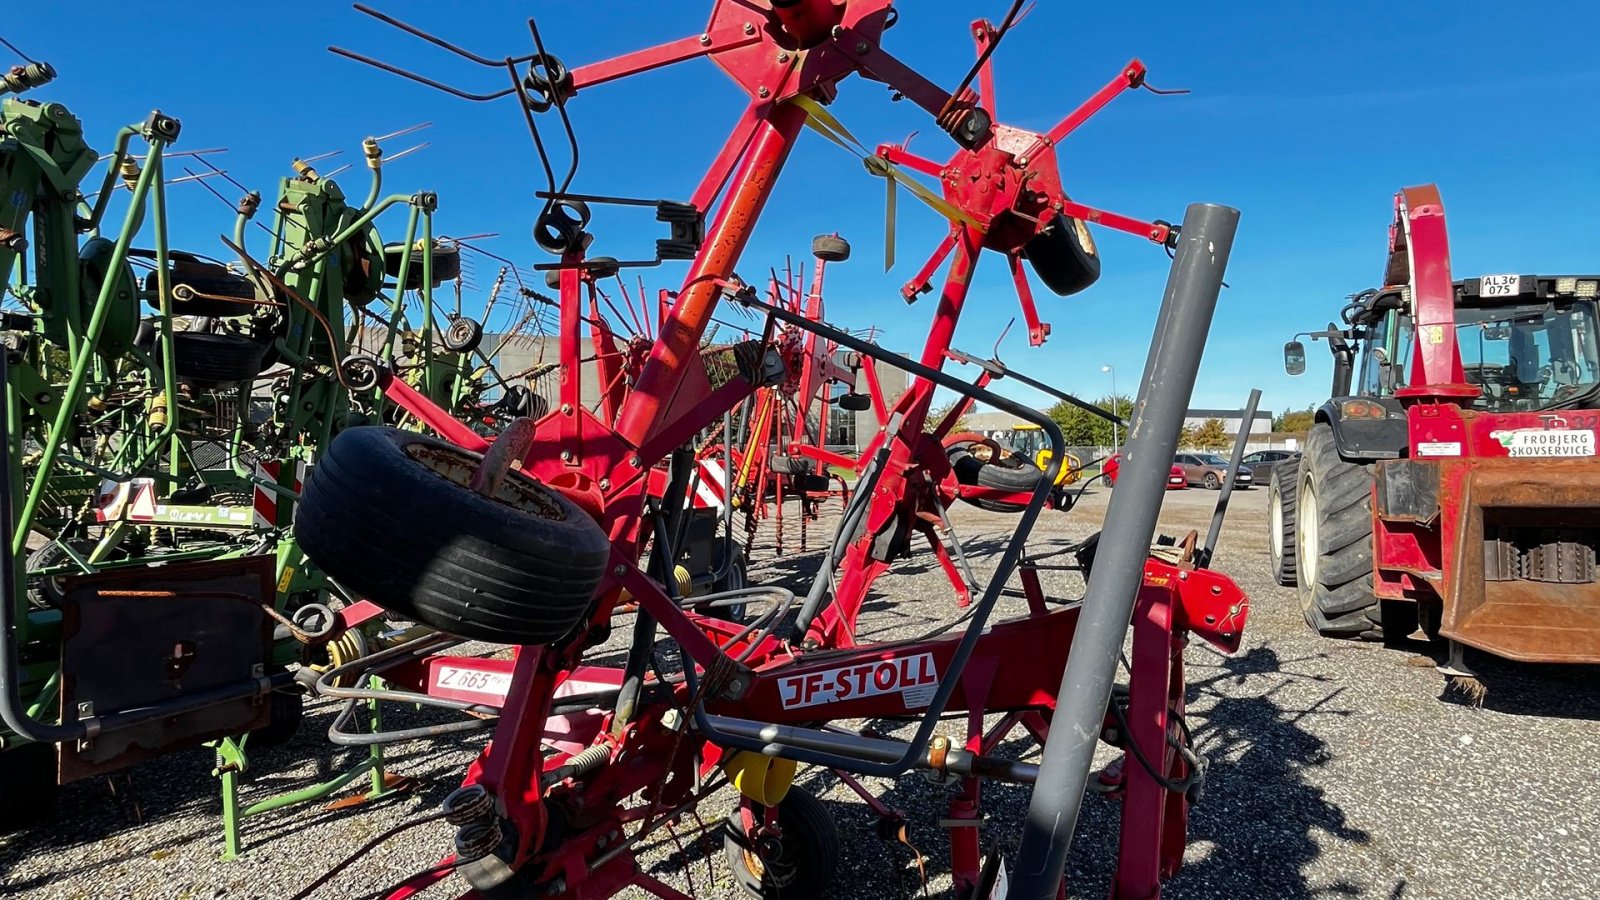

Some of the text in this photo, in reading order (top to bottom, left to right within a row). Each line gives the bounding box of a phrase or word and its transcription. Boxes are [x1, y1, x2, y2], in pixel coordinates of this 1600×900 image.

[1485, 277, 1499, 286] AL
[1489, 285, 1510, 295] 075
[1512, 446, 1588, 455] SKOVSERVICE
[440, 669, 459, 685] Z
[457, 671, 491, 689] 665
[785, 656, 935, 706] JF-STOLL
